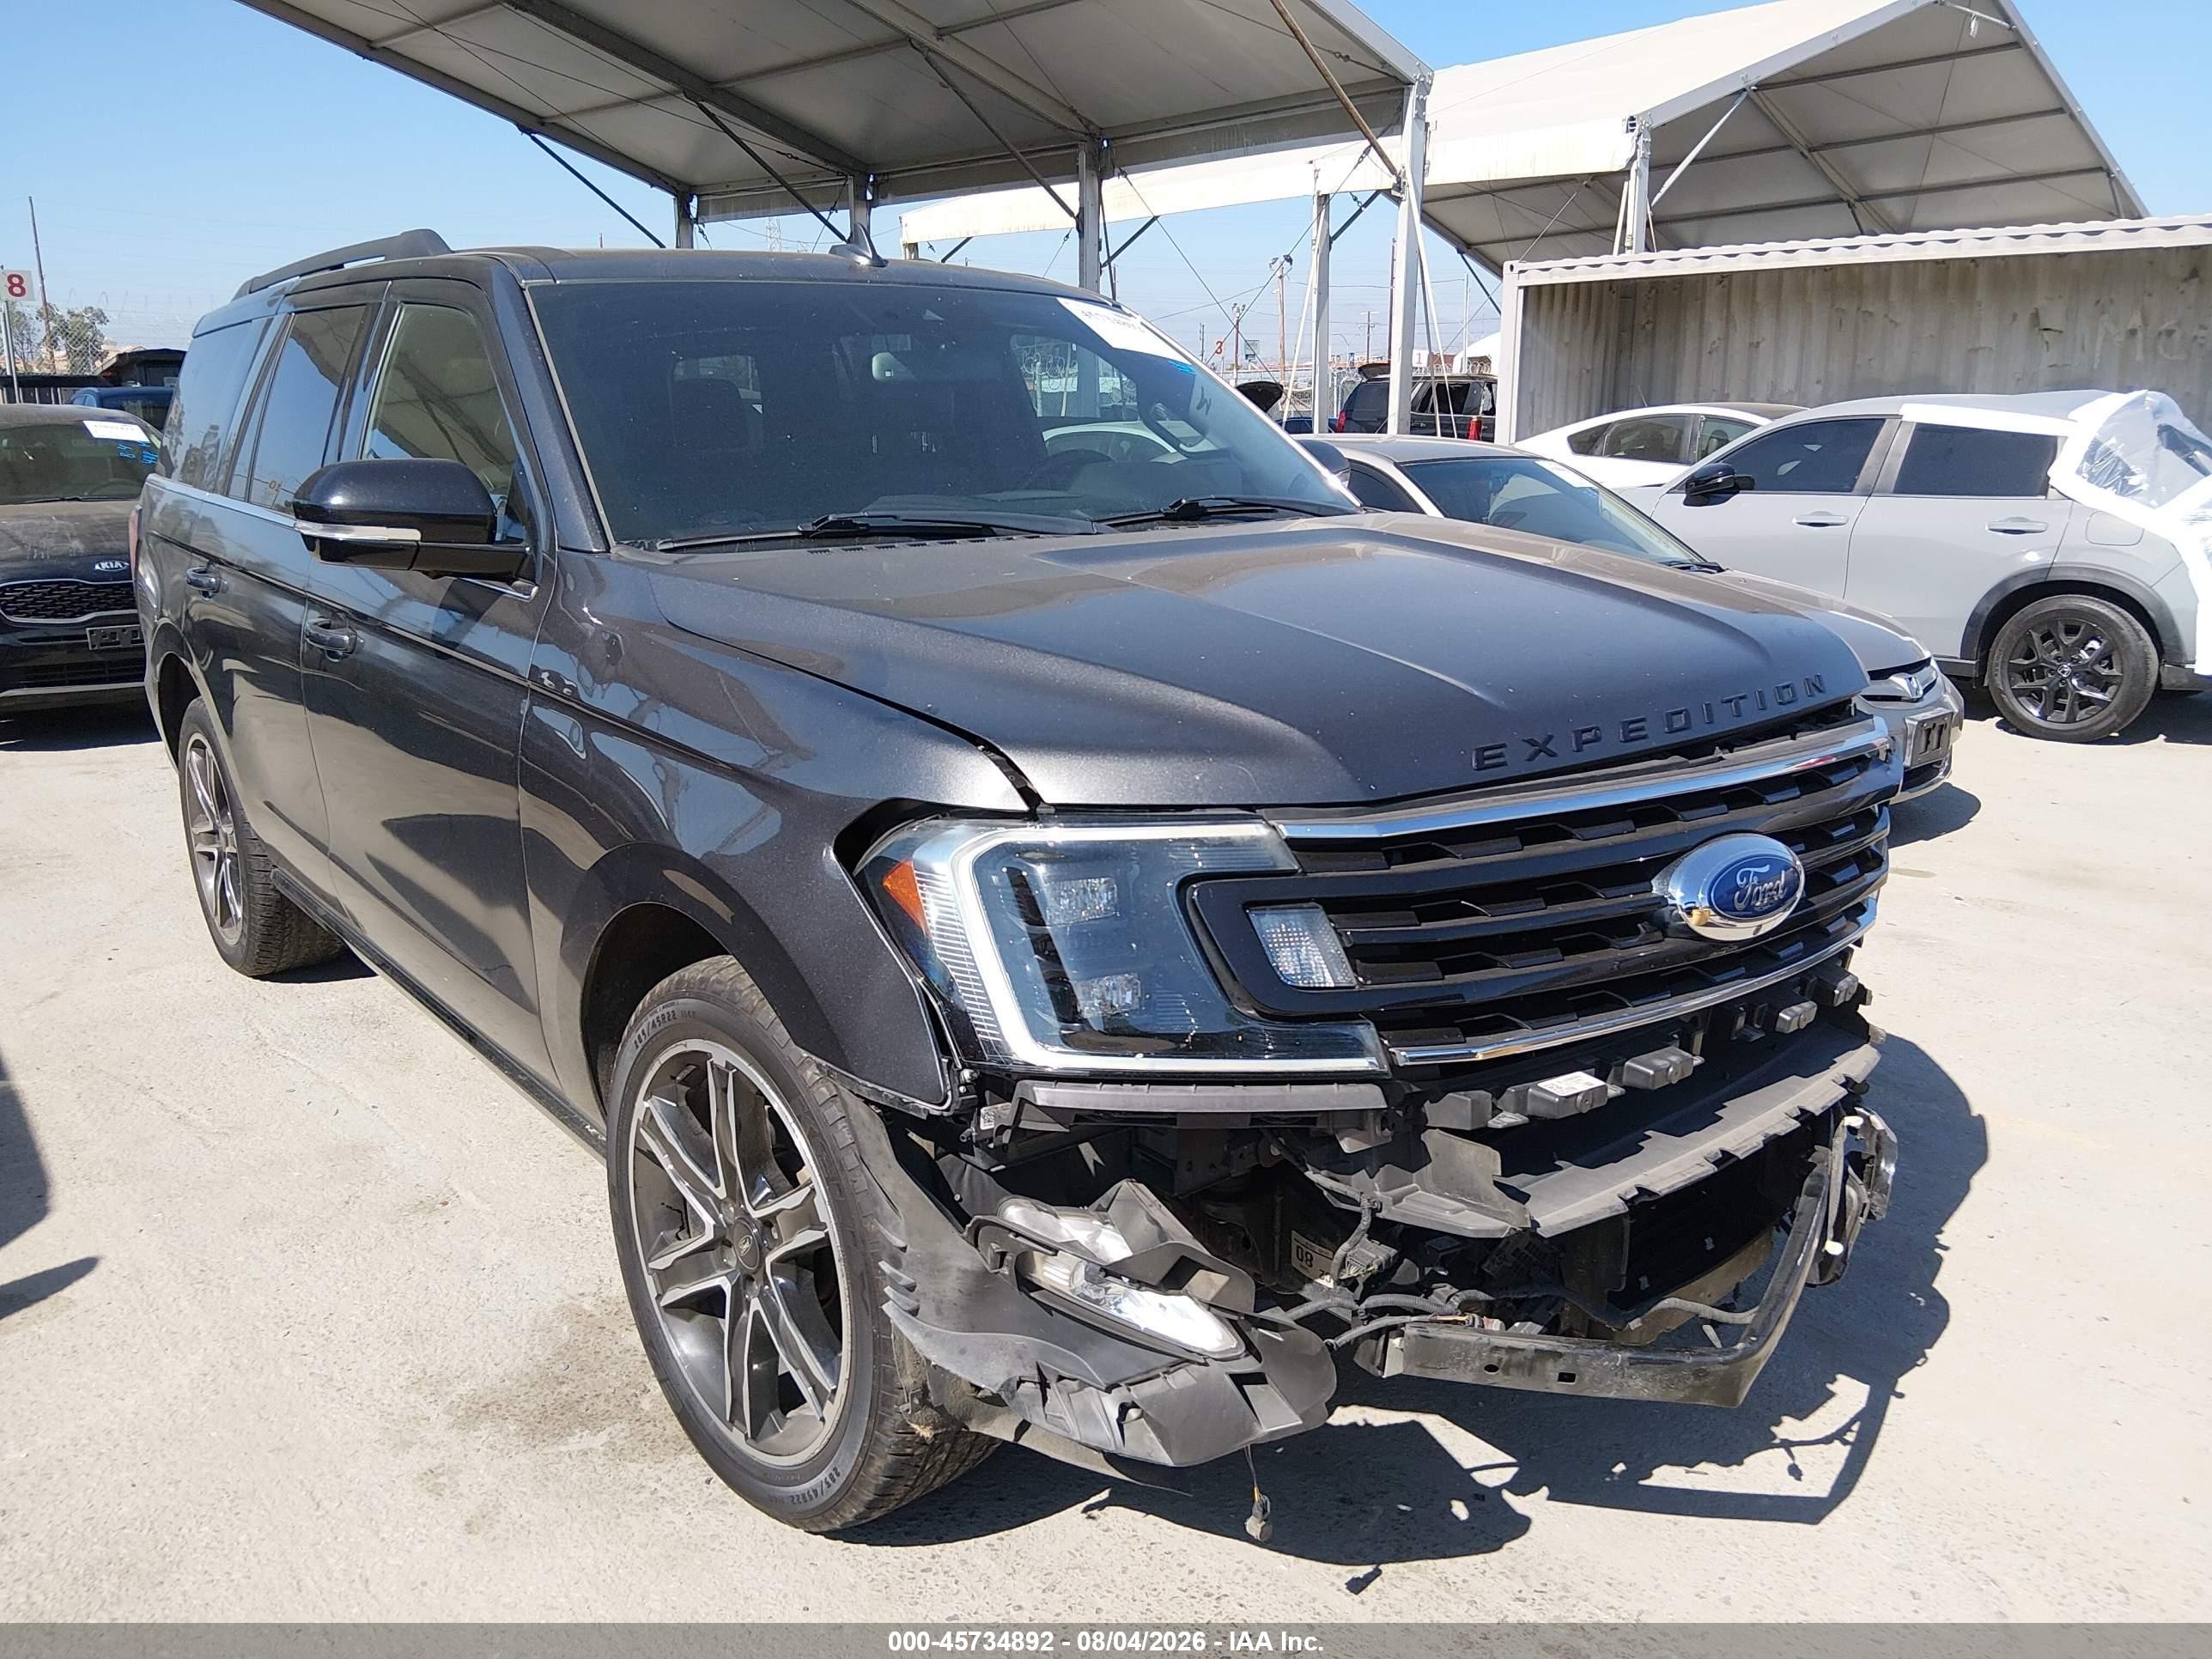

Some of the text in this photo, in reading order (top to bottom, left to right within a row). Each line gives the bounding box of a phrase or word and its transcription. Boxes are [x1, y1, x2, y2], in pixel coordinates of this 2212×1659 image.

[7, 273, 27, 298] 8
[1415, 352, 1423, 365] 1
[99, 560, 125, 570] KIA
[1471, 672, 1826, 771] EXPEDITION
[1734, 864, 1787, 911] Ford
[1296, 1244, 1314, 1268] 08
